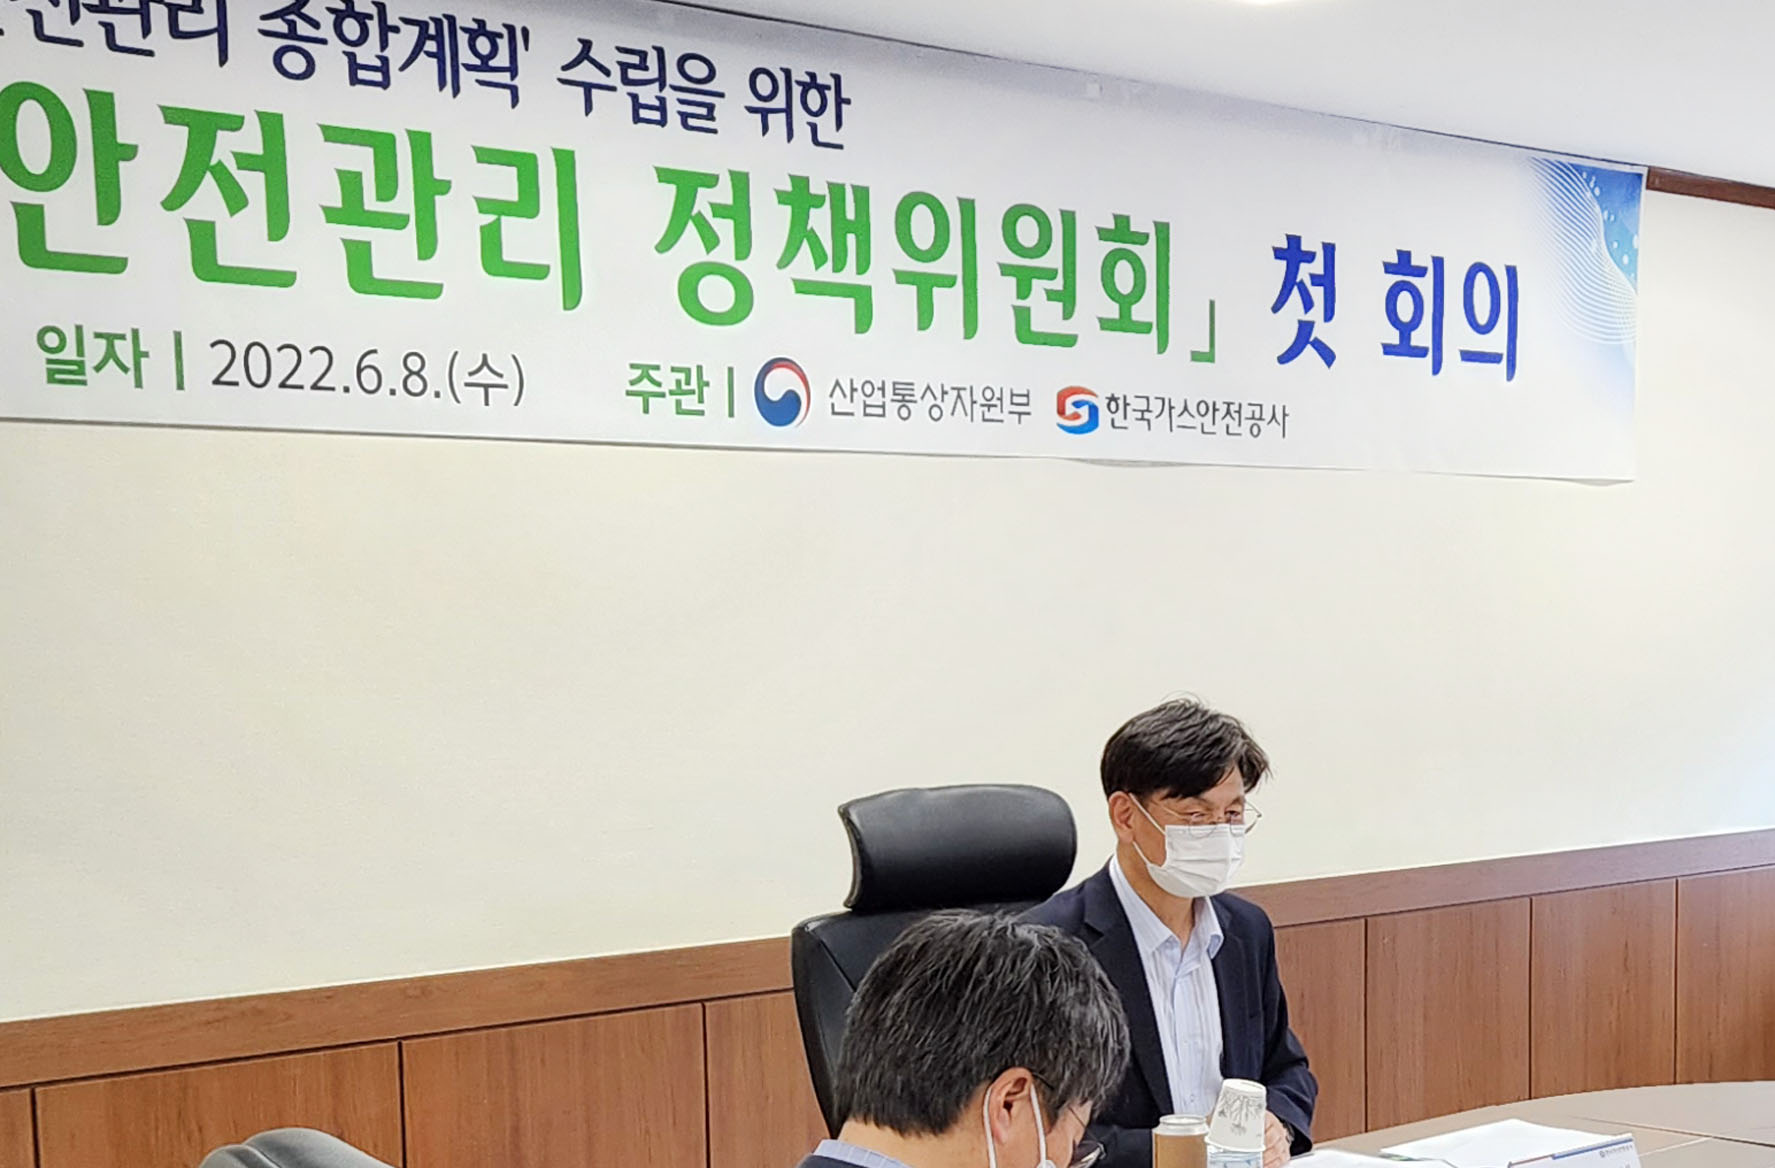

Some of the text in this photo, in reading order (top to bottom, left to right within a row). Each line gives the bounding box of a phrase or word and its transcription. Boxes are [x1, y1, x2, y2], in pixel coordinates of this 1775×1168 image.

[0, 0, 228, 67] 전관리
[556, 38, 726, 135] 수립을
[744, 66, 852, 150] 위한
[0, 80, 583, 310] 안전관리
[1270, 233, 1337, 369] 첫
[1381, 249, 1519, 382] 회의
[36, 324, 525, 407] 일자 2022.6.8.(수)
[625, 361, 1289, 438] 주관 산업통상자원부 한국가스안전공사
